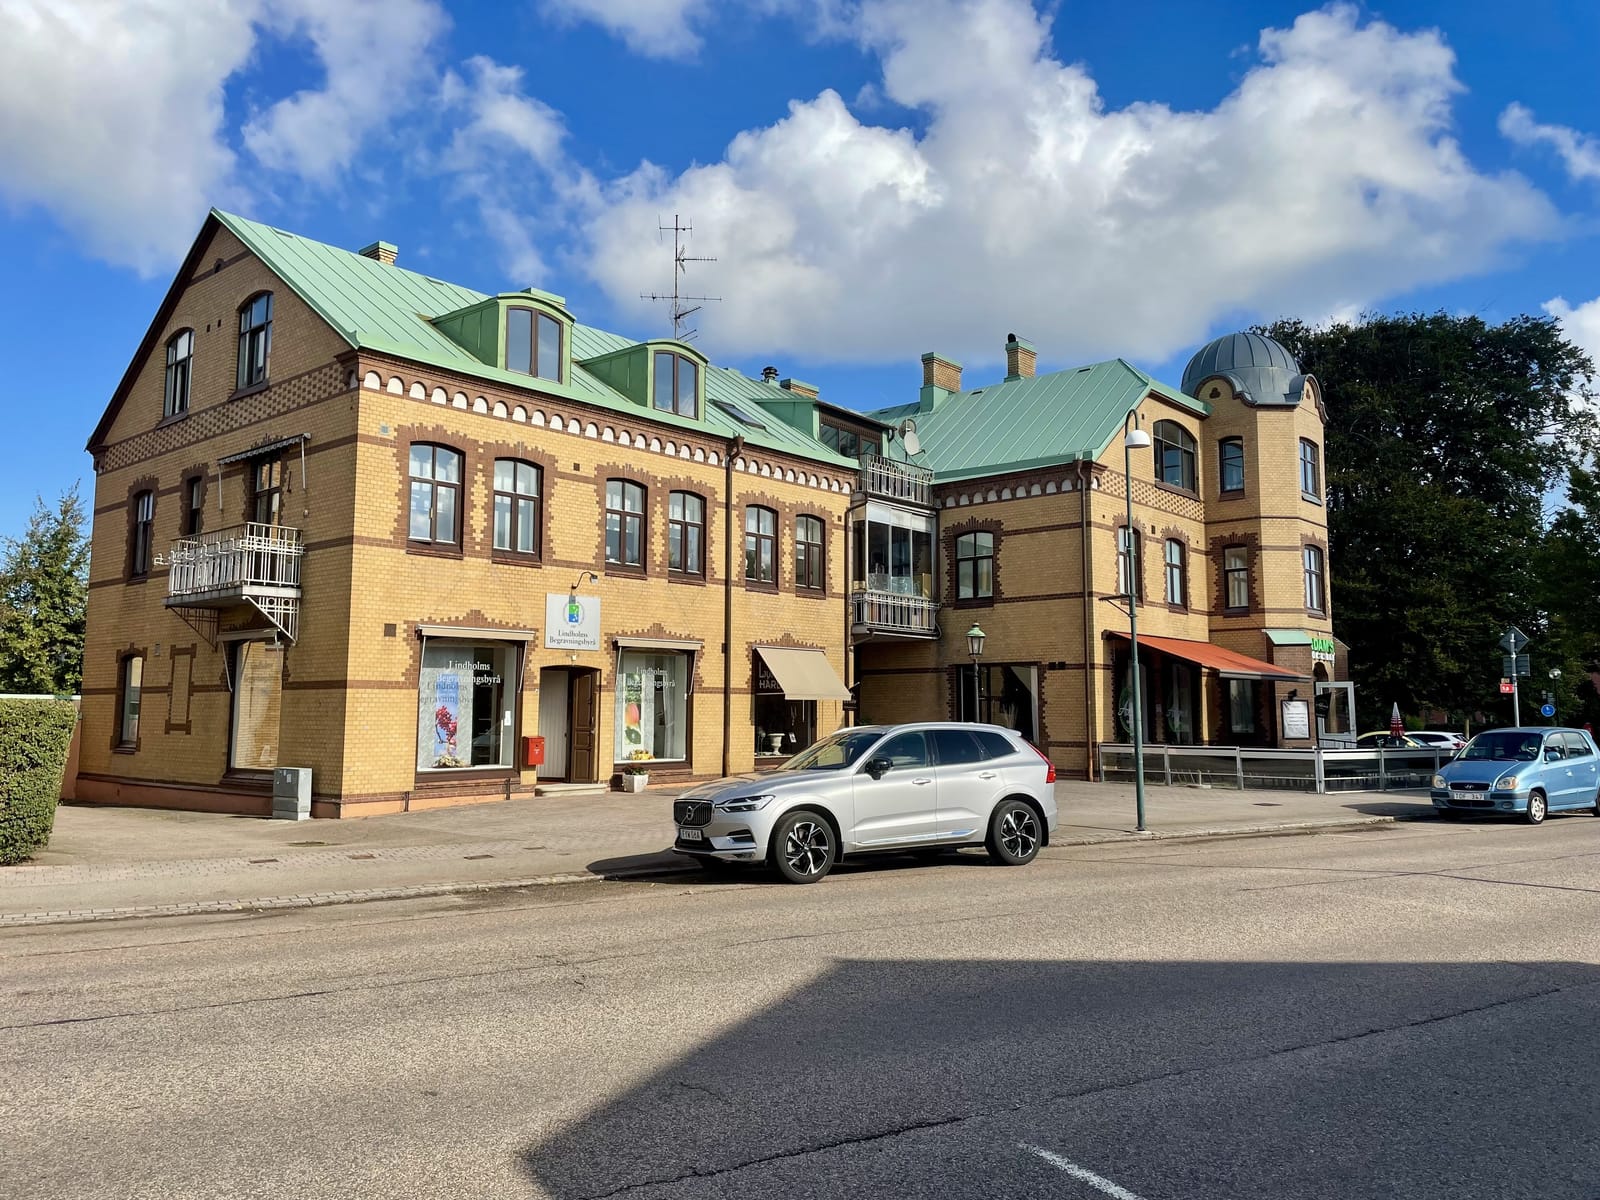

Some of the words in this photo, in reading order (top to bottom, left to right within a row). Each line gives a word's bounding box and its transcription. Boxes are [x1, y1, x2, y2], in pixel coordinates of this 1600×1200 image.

[558, 629, 588, 638] Lindholms
[549, 635, 596, 646] Begravningsbyrå
[448, 660, 491, 671] Lindholms
[437, 673, 501, 686] Begrangsbyrå
[627, 679, 676, 689] Begrngsbyrå
